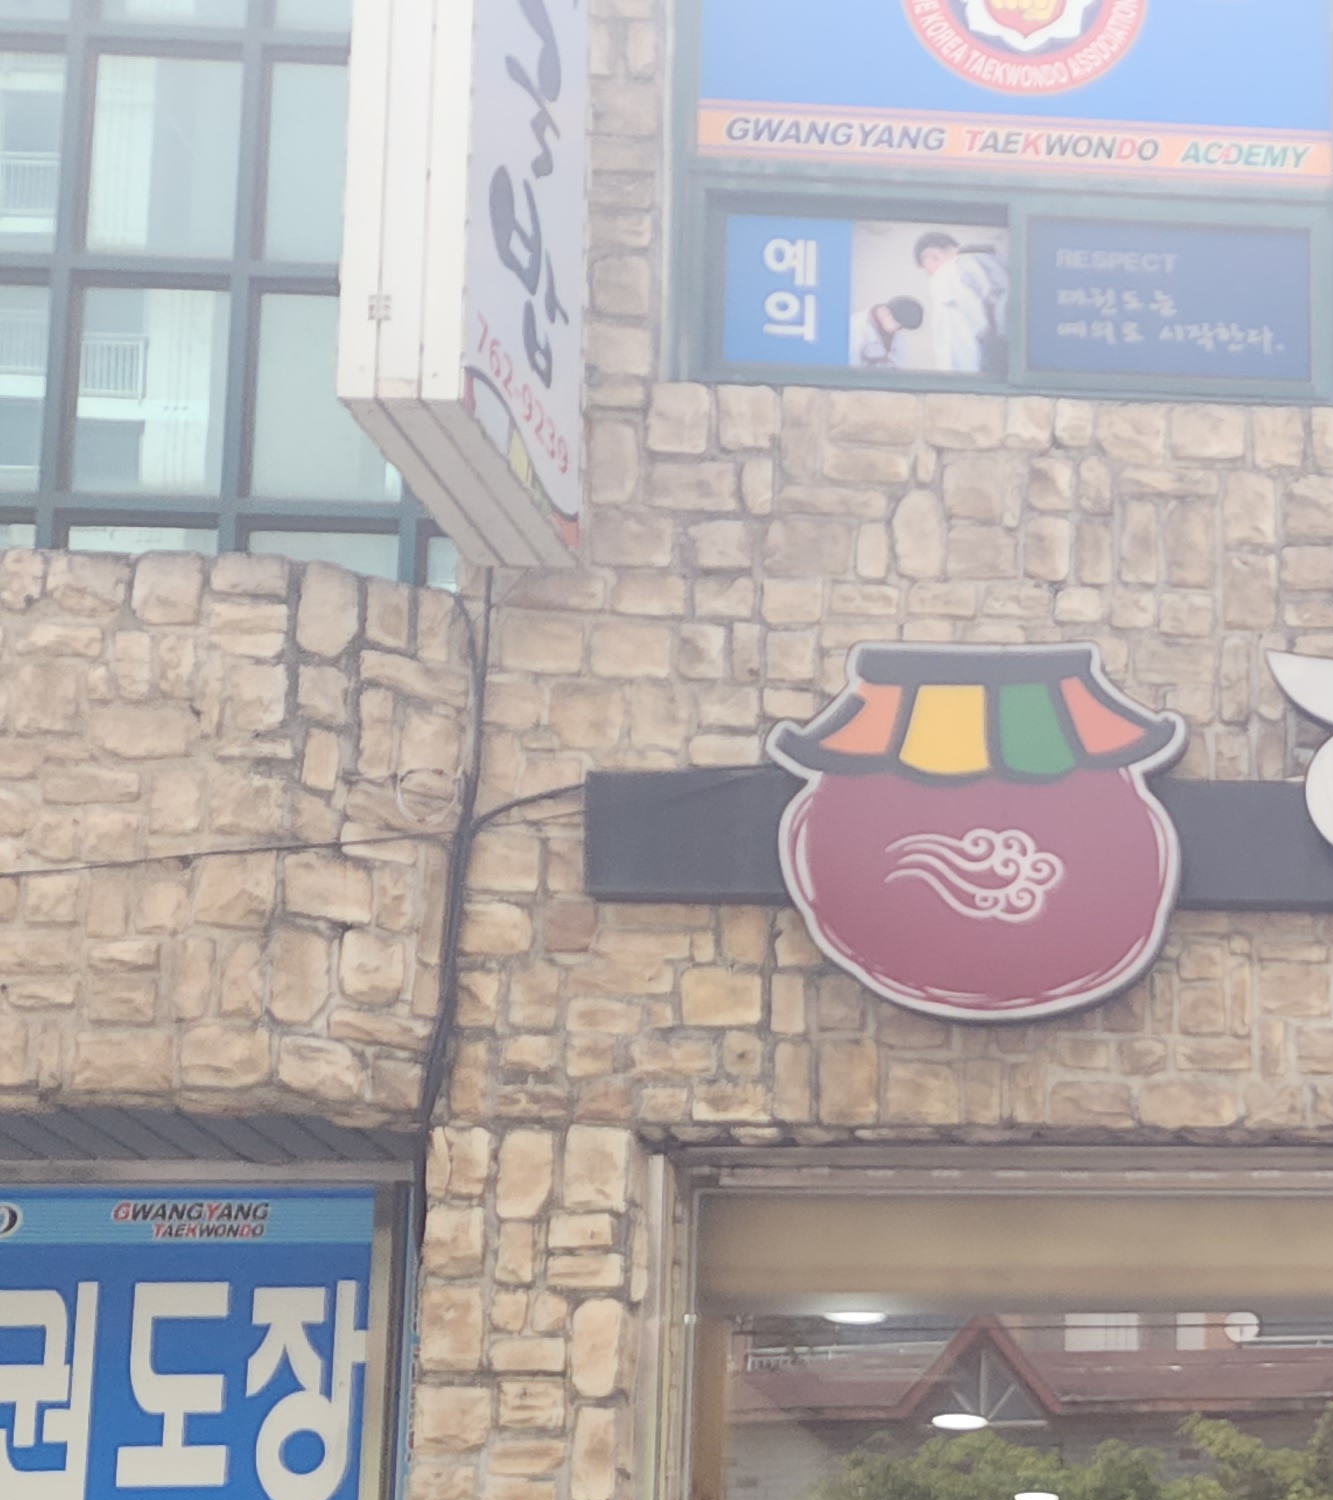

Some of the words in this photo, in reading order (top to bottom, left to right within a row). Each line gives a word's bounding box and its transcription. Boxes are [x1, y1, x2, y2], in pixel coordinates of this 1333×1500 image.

[963, 49, 1070, 88] TAEKWONDO
[725, 116, 946, 151] GWANGYANG
[964, 127, 1159, 161] TAEKWONDO
[1056, 249, 1177, 273] RESPECT
[763, 237, 817, 342] 예의
[112, 1202, 269, 1222] GWANGYANG
[153, 1223, 265, 1238] TAEKWONDO
